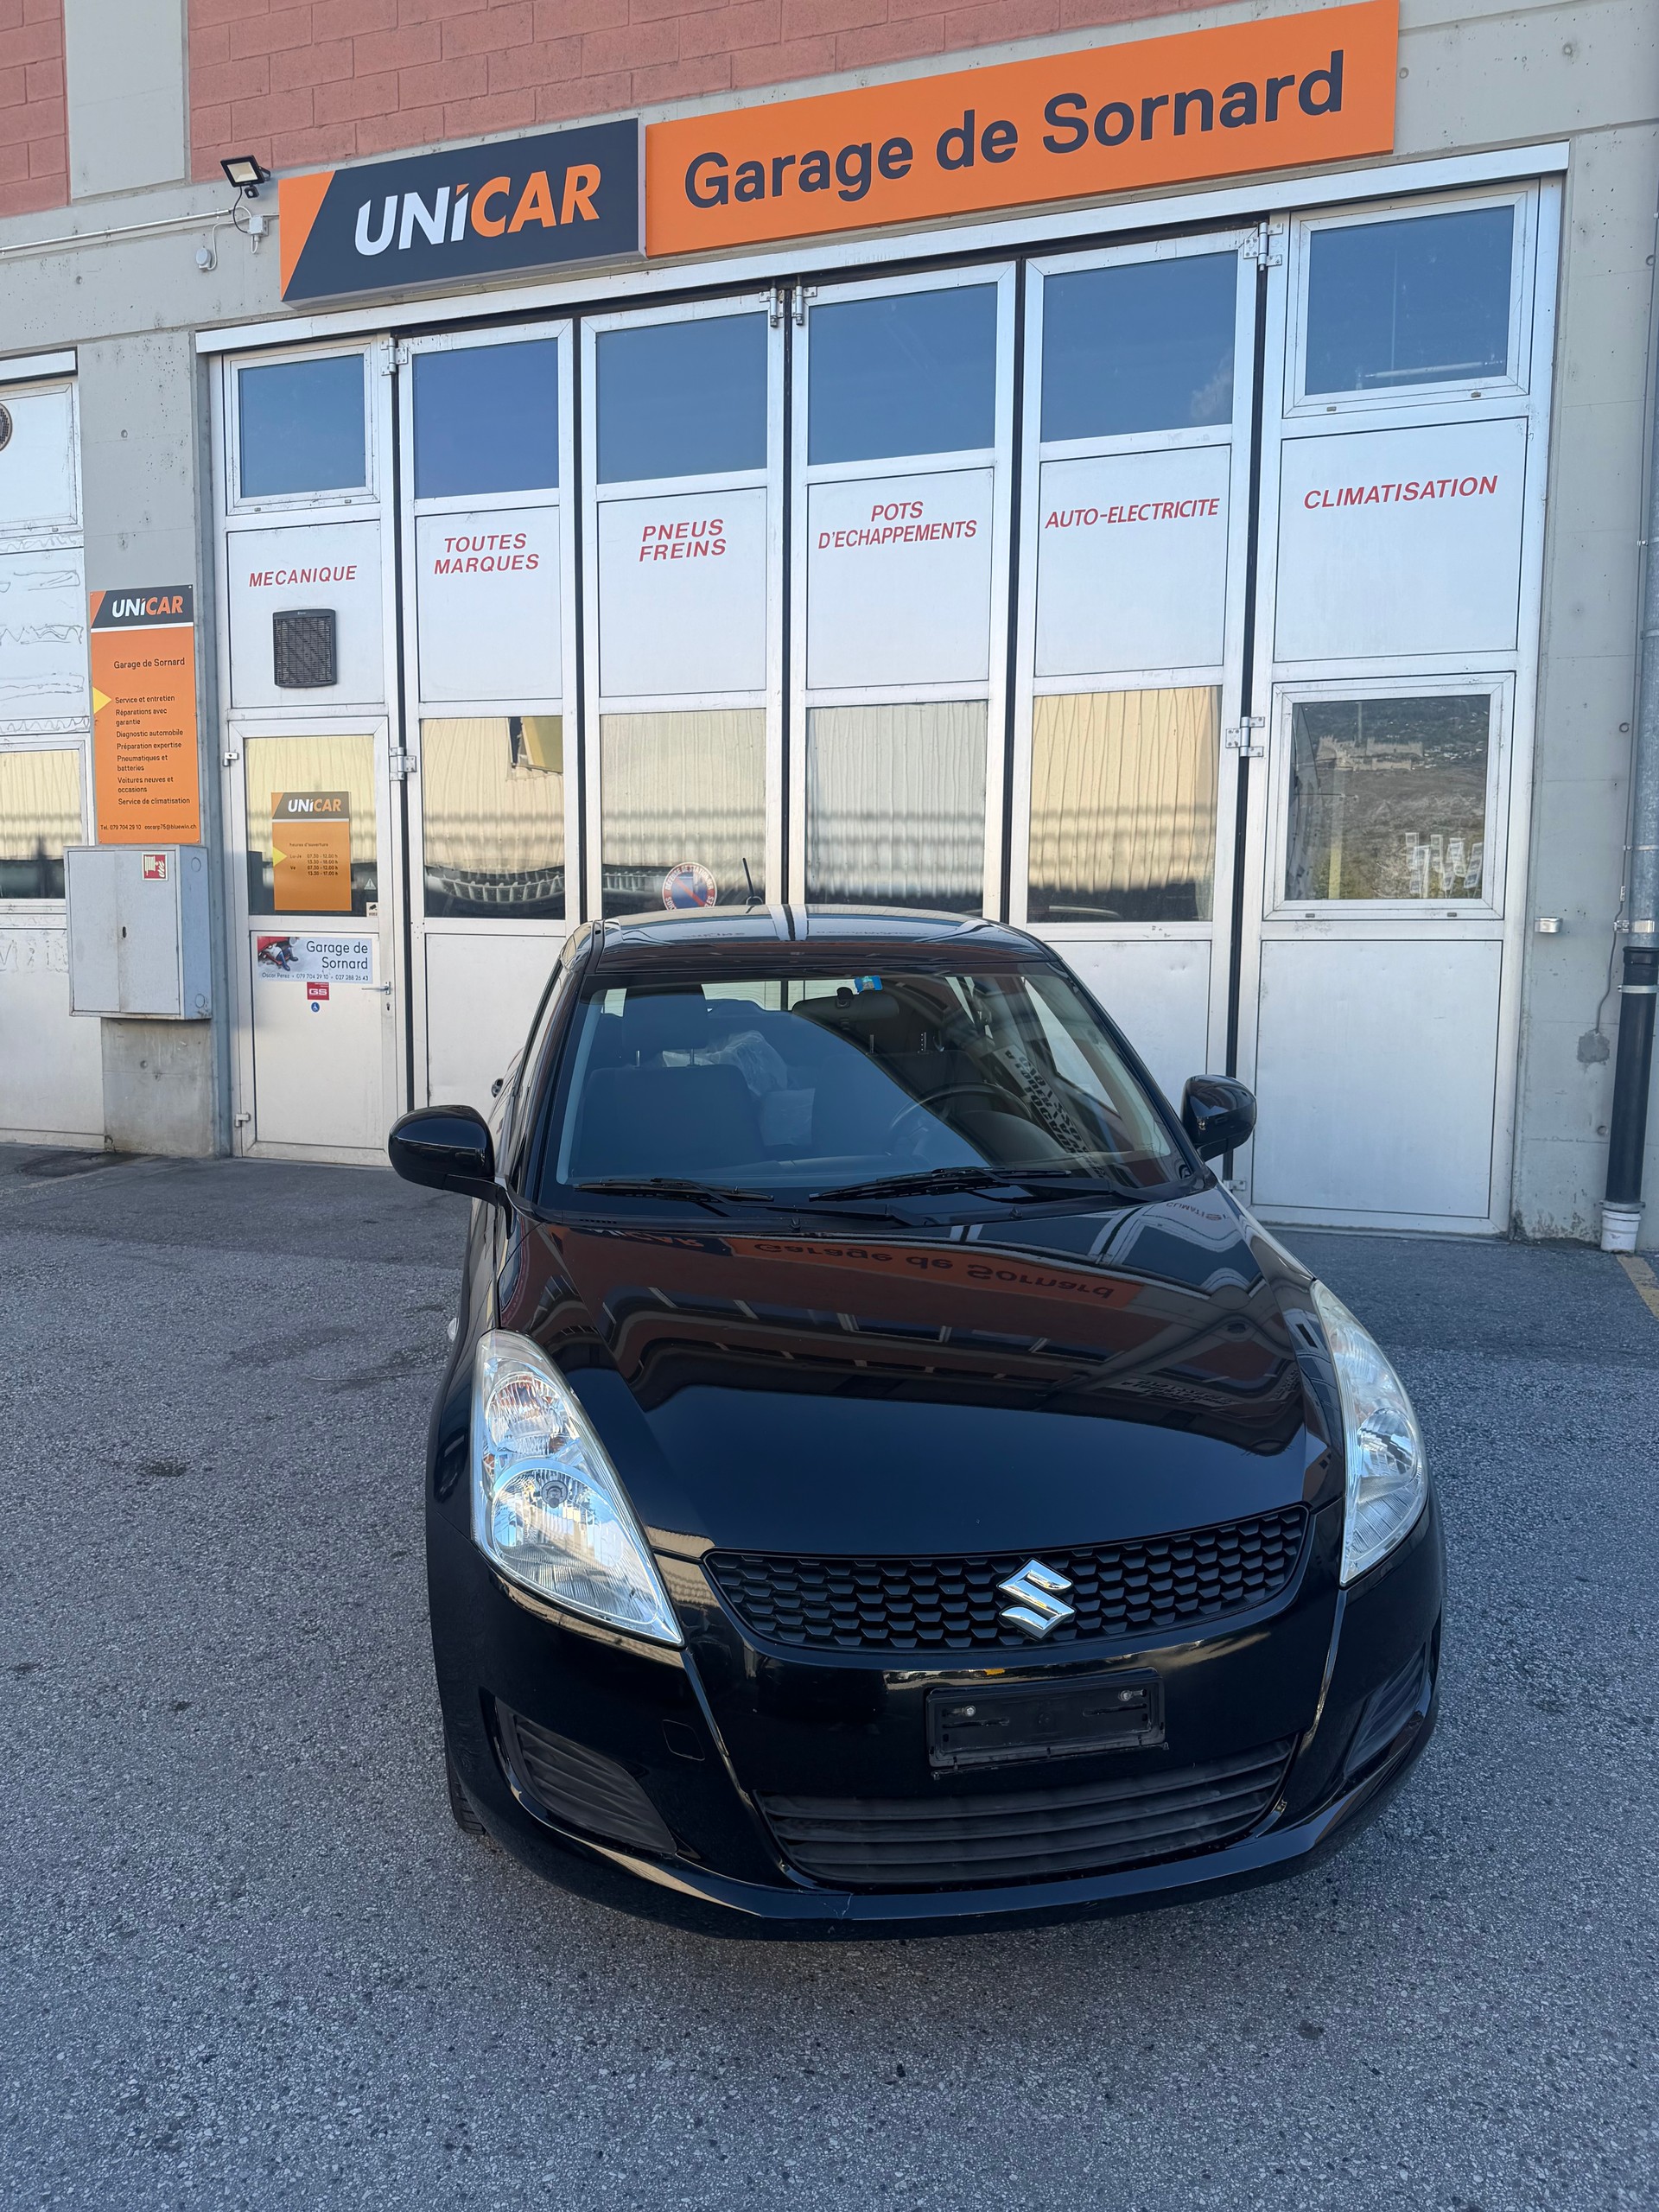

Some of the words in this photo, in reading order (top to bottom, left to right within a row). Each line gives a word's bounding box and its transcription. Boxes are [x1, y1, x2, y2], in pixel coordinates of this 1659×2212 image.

[684, 137, 913, 208] Garage
[937, 110, 1018, 170] de
[1042, 49, 1344, 154] Sornard
[1304, 475, 1497, 510] CLIMATISATION
[870, 501, 924, 522] POTS
[1045, 498, 1219, 529] AUTO-ELECTRICITE
[642, 519, 724, 542] PNEUS
[817, 520, 977, 549] D'ECHAPPEMENTS
[444, 533, 527, 553] TOUTES
[639, 539, 727, 563] FREINS
[434, 554, 540, 575] MARQUES
[248, 565, 357, 588] MECANIQUE
[114, 660, 141, 670] Garage
[154, 658, 185, 666] Sornard
[116, 709, 152, 717] Réparations
[117, 742, 152, 751] Préparation
[307, 941, 349, 956] Garage
[353, 942, 368, 954] de
[322, 957, 368, 969] Sornard
